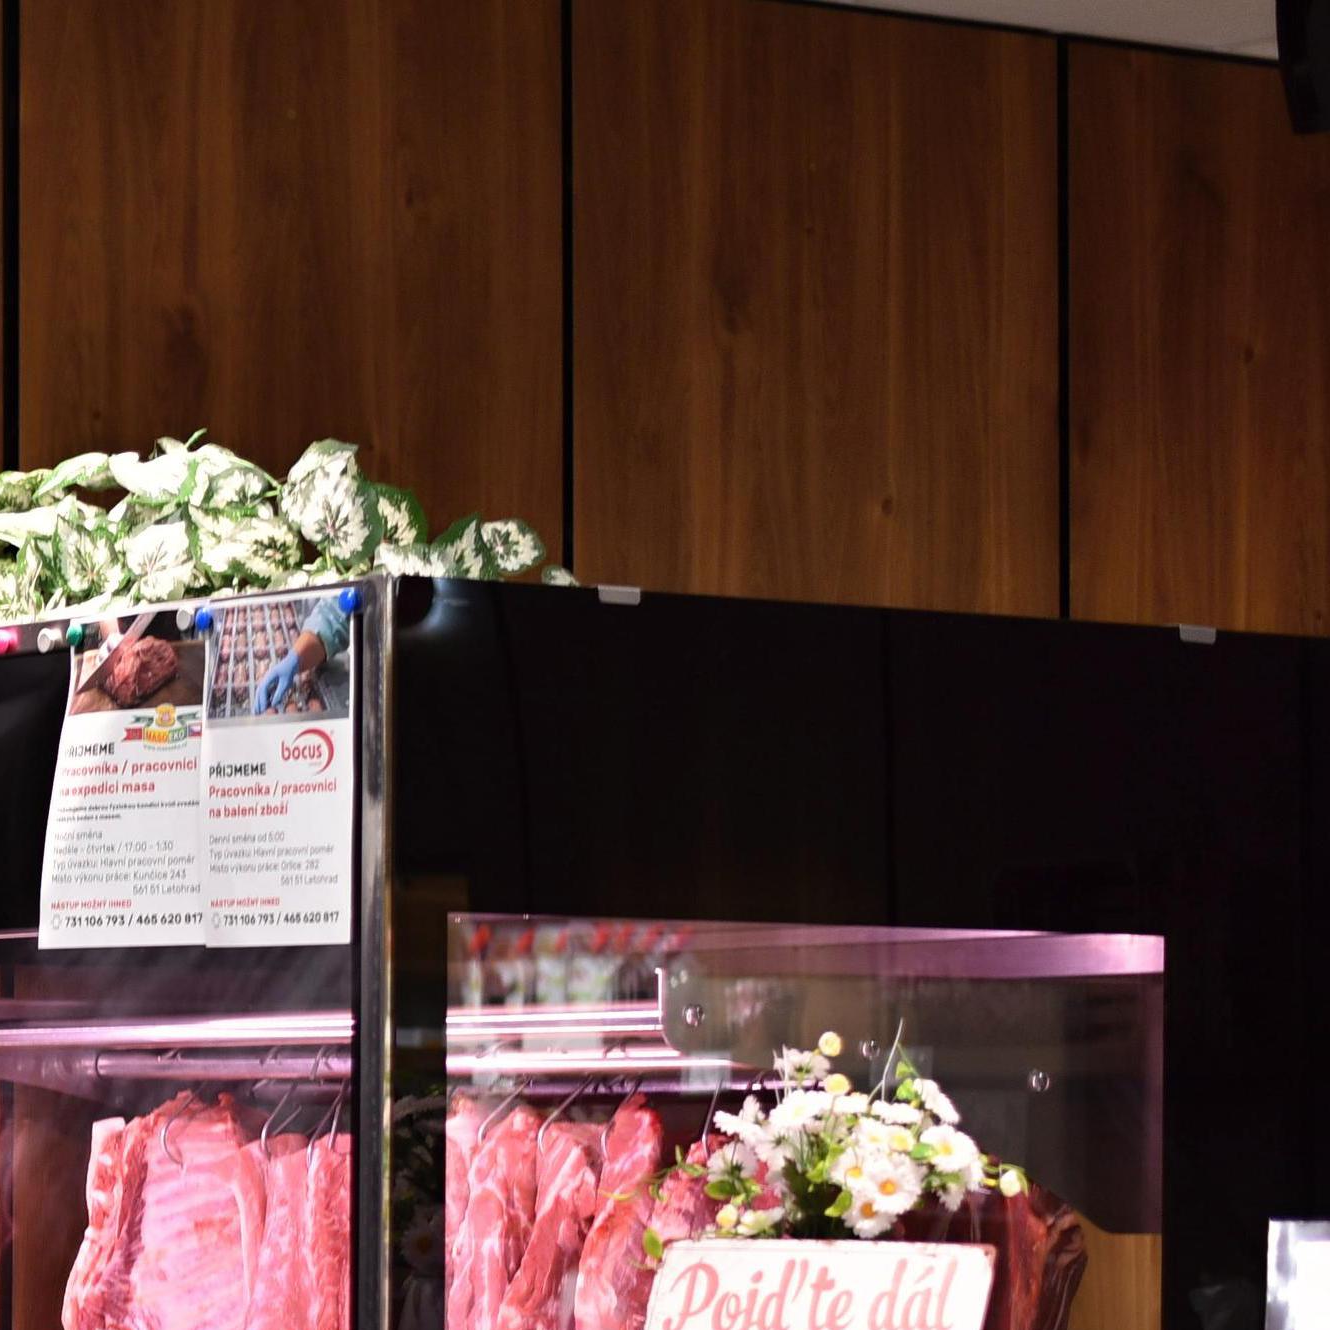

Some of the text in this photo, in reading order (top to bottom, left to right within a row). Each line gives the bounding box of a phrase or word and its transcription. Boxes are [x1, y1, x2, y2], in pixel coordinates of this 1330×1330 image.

[280, 740, 323, 761] bocus
[209, 760, 267, 778] PŘIJMEME
[121, 782, 155, 794] masa
[209, 781, 271, 798] Pracovníka
[209, 801, 289, 819] na balení zboží
[65, 916, 82, 928] 731
[85, 915, 103, 927] 106
[106, 914, 125, 927] 793
[136, 913, 158, 926] 465
[160, 913, 182, 925] 620
[223, 913, 238, 927] 731
[239, 913, 256, 926] 106
[258, 912, 275, 926] 793
[283, 912, 301, 924] 465
[303, 912, 321, 924] 620
